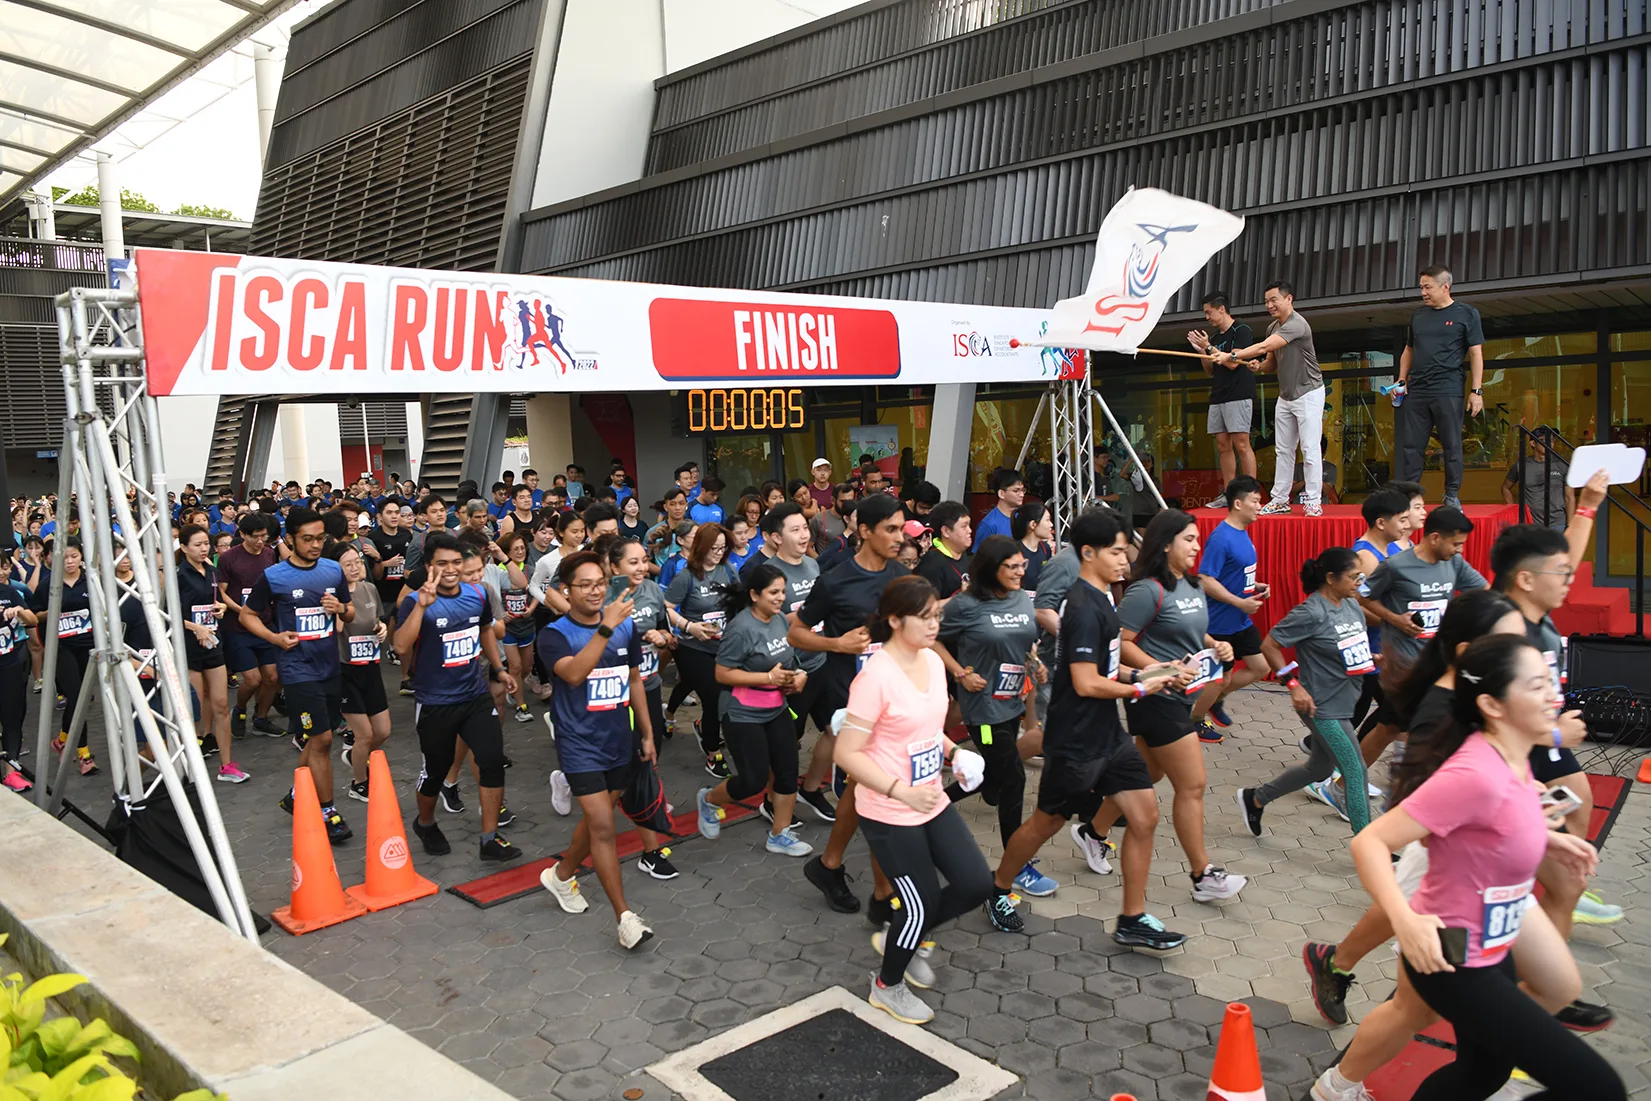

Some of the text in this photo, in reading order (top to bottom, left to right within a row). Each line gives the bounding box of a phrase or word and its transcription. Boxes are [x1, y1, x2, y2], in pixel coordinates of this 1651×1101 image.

[211, 274, 508, 371] ISCA RUN
[733, 310, 839, 371] FINISH
[952, 331, 993, 357] ISCA
[688, 388, 805, 432] 00:00:05
[299, 614, 326, 632] 7180
[350, 642, 374, 657] 8353
[444, 637, 474, 658] 7409
[589, 677, 622, 700] 7406
[998, 673, 1022, 690] 7194
